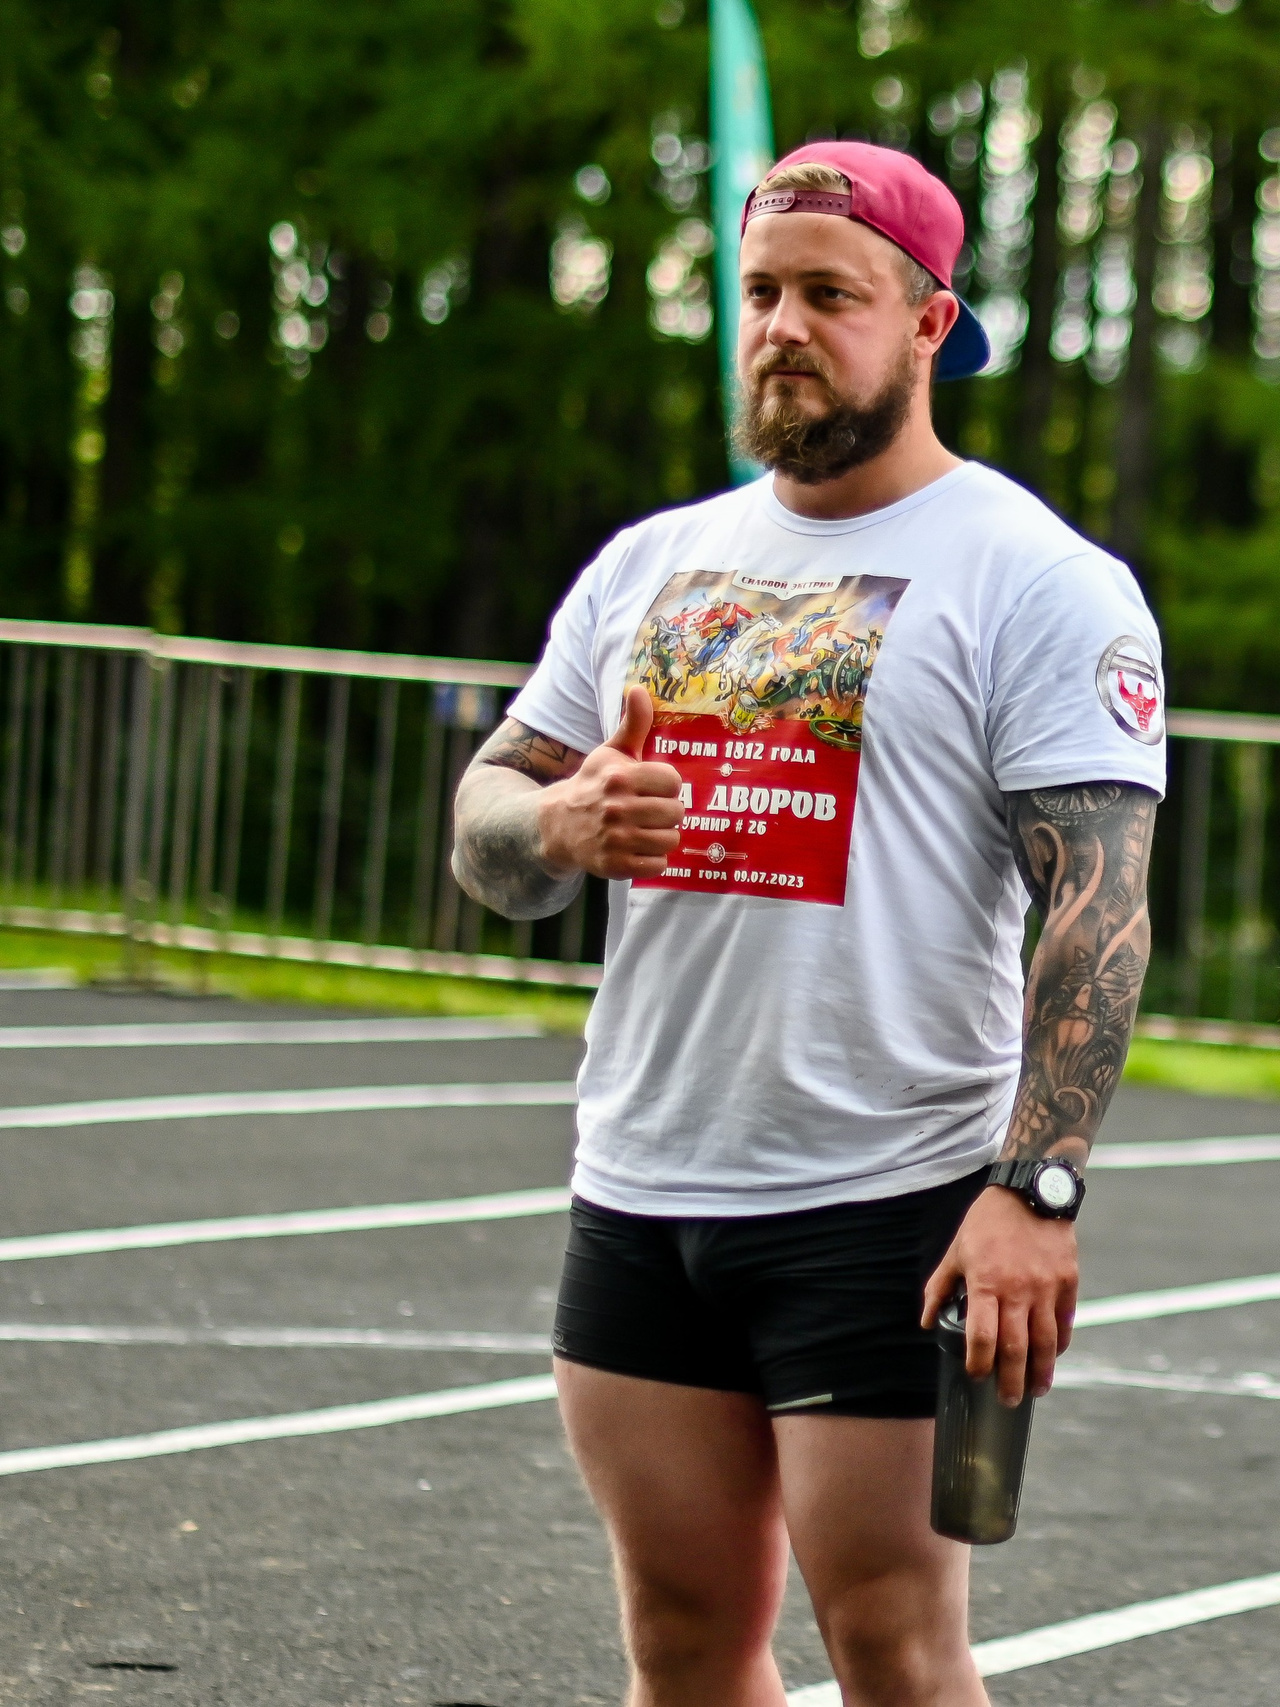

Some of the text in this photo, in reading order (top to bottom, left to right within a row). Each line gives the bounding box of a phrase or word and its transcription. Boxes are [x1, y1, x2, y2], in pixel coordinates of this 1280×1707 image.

[741, 576, 835, 591] СИЛОВОЙ ЭКСТРИМ
[725, 740, 765, 760] 1812
[706, 784, 837, 821] ДВОРОВ
[674, 816, 768, 835] УРНИР # 26
[699, 869, 728, 881] ГОРА
[734, 870, 805, 889] 09.07.2023
